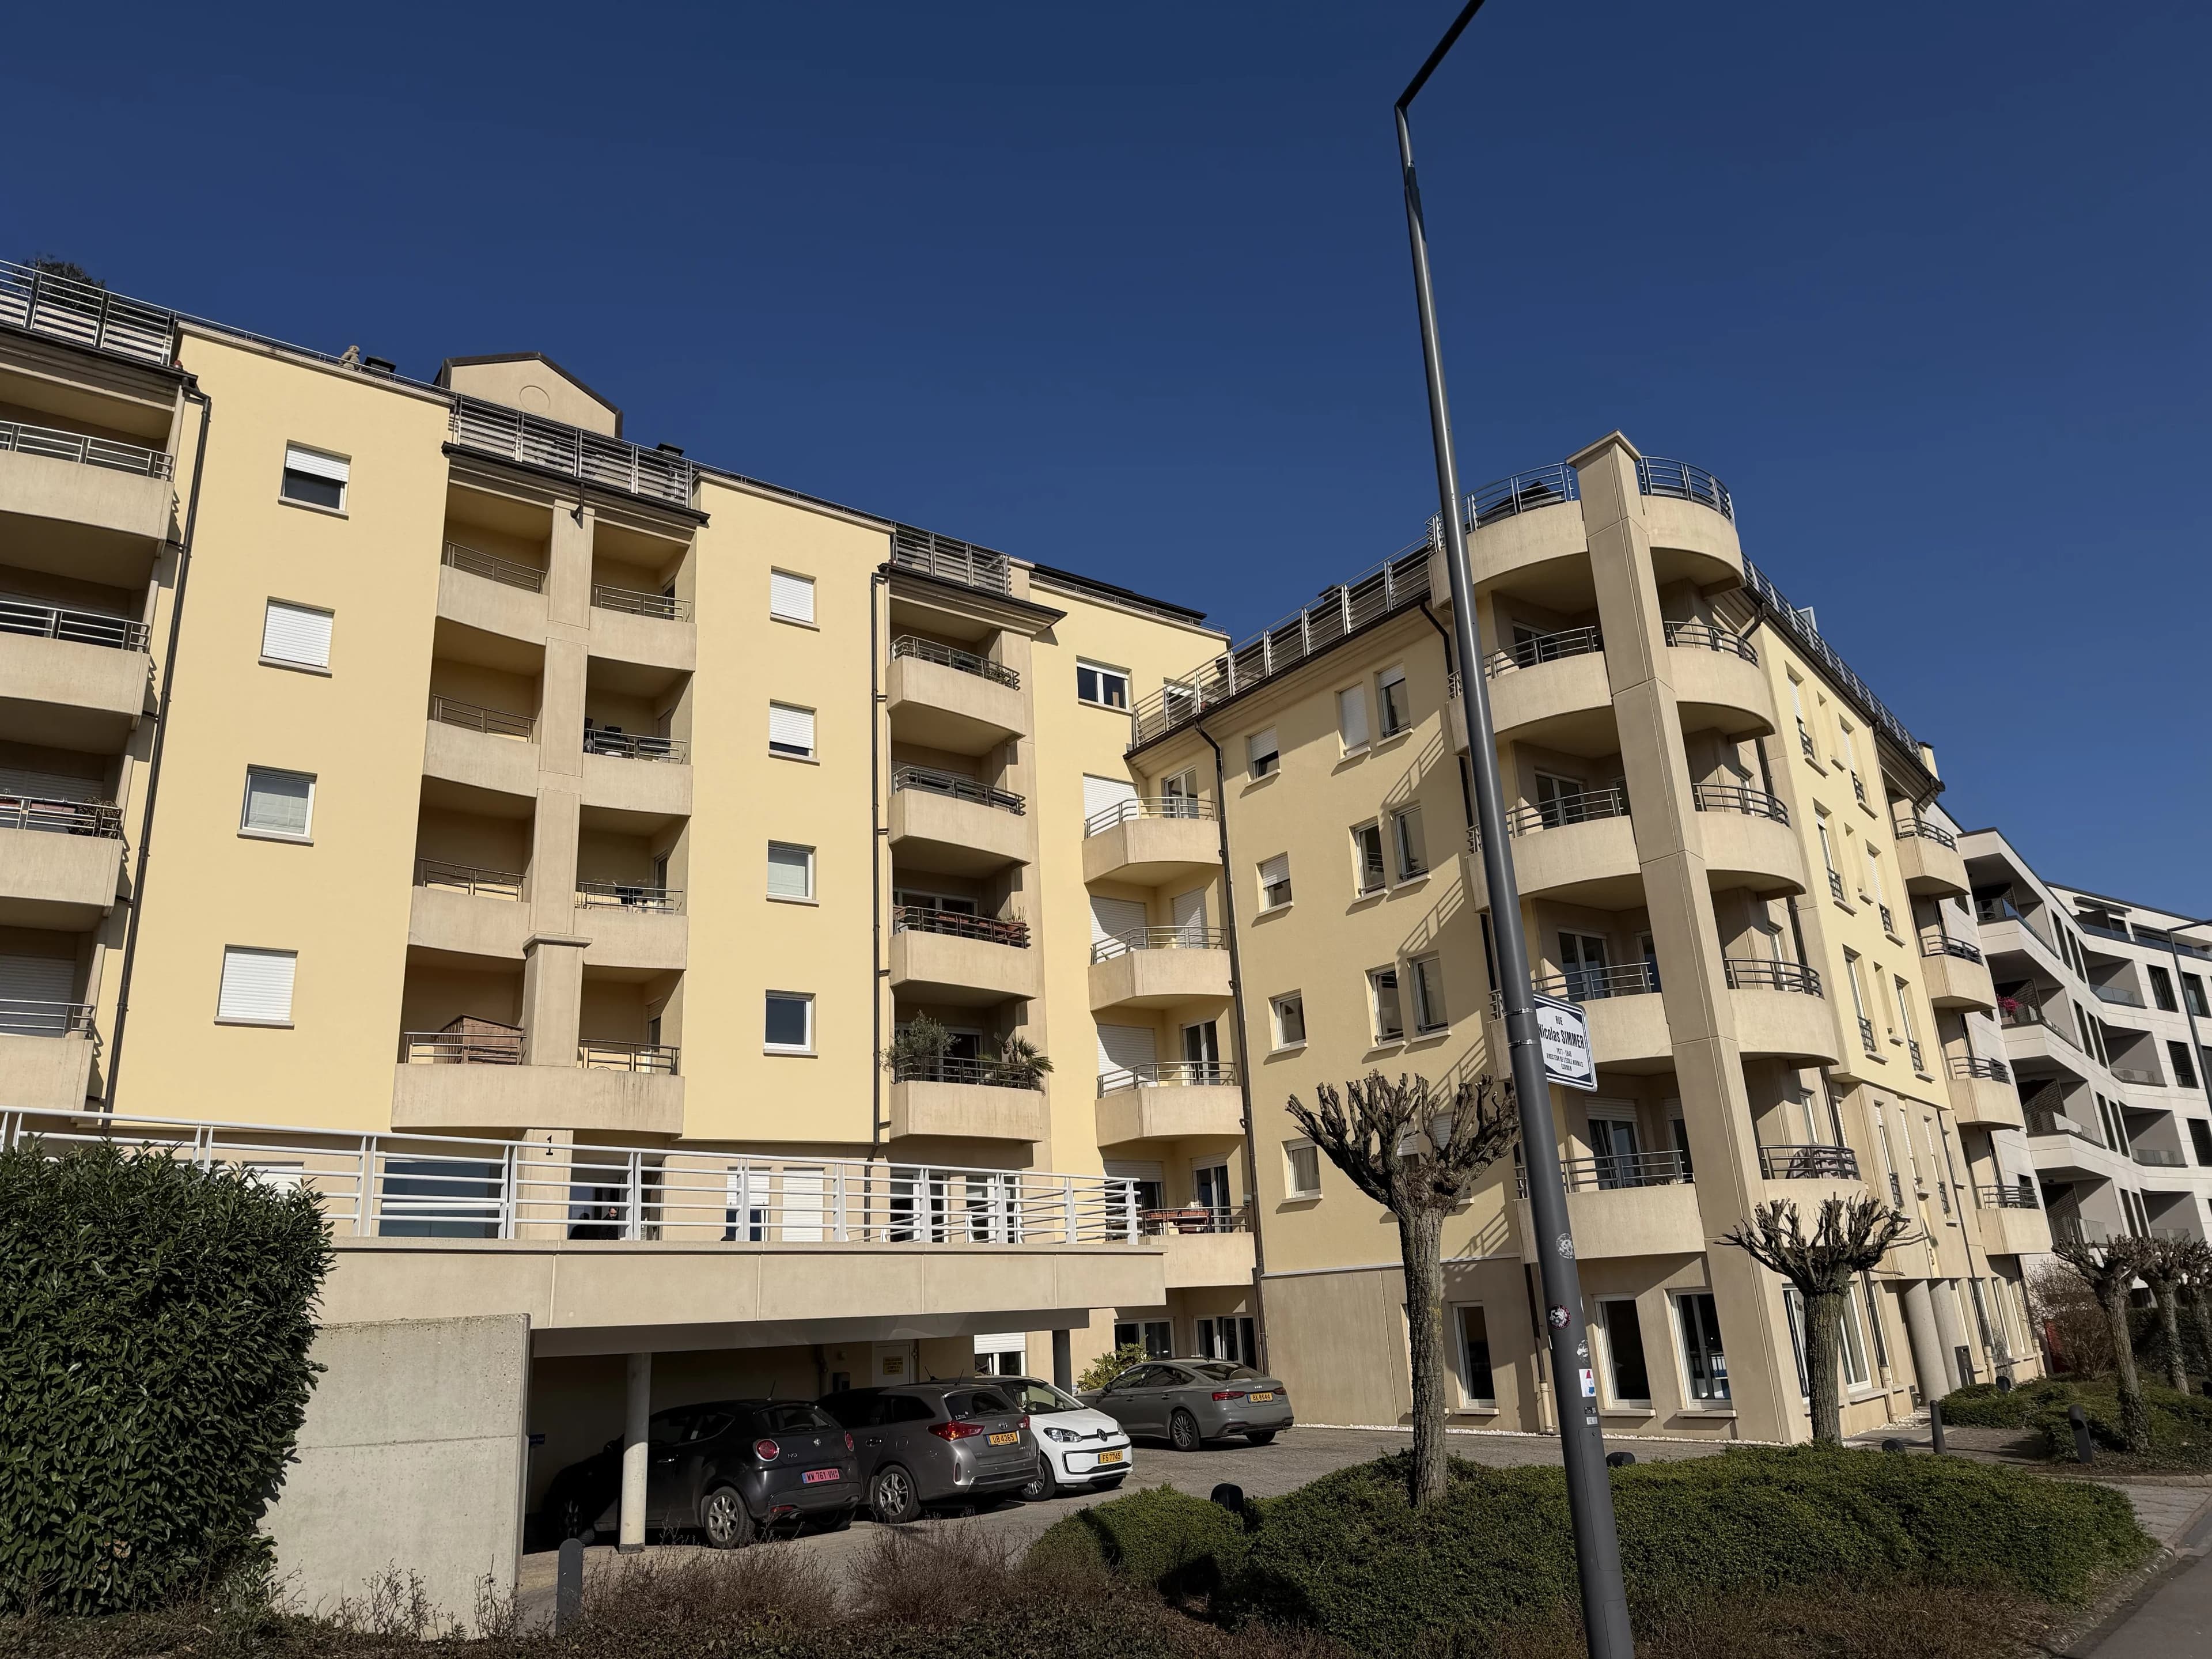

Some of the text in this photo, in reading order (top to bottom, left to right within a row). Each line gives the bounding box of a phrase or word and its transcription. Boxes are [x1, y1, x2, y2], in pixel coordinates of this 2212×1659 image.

[1539, 1023, 1585, 1049] Nicolas SIMMER
[546, 1135, 553, 1156] 1
[993, 1433, 1014, 1444] UB 4365
[1102, 1452, 1121, 1462] FS 7745
[816, 1471, 827, 1480] 761
